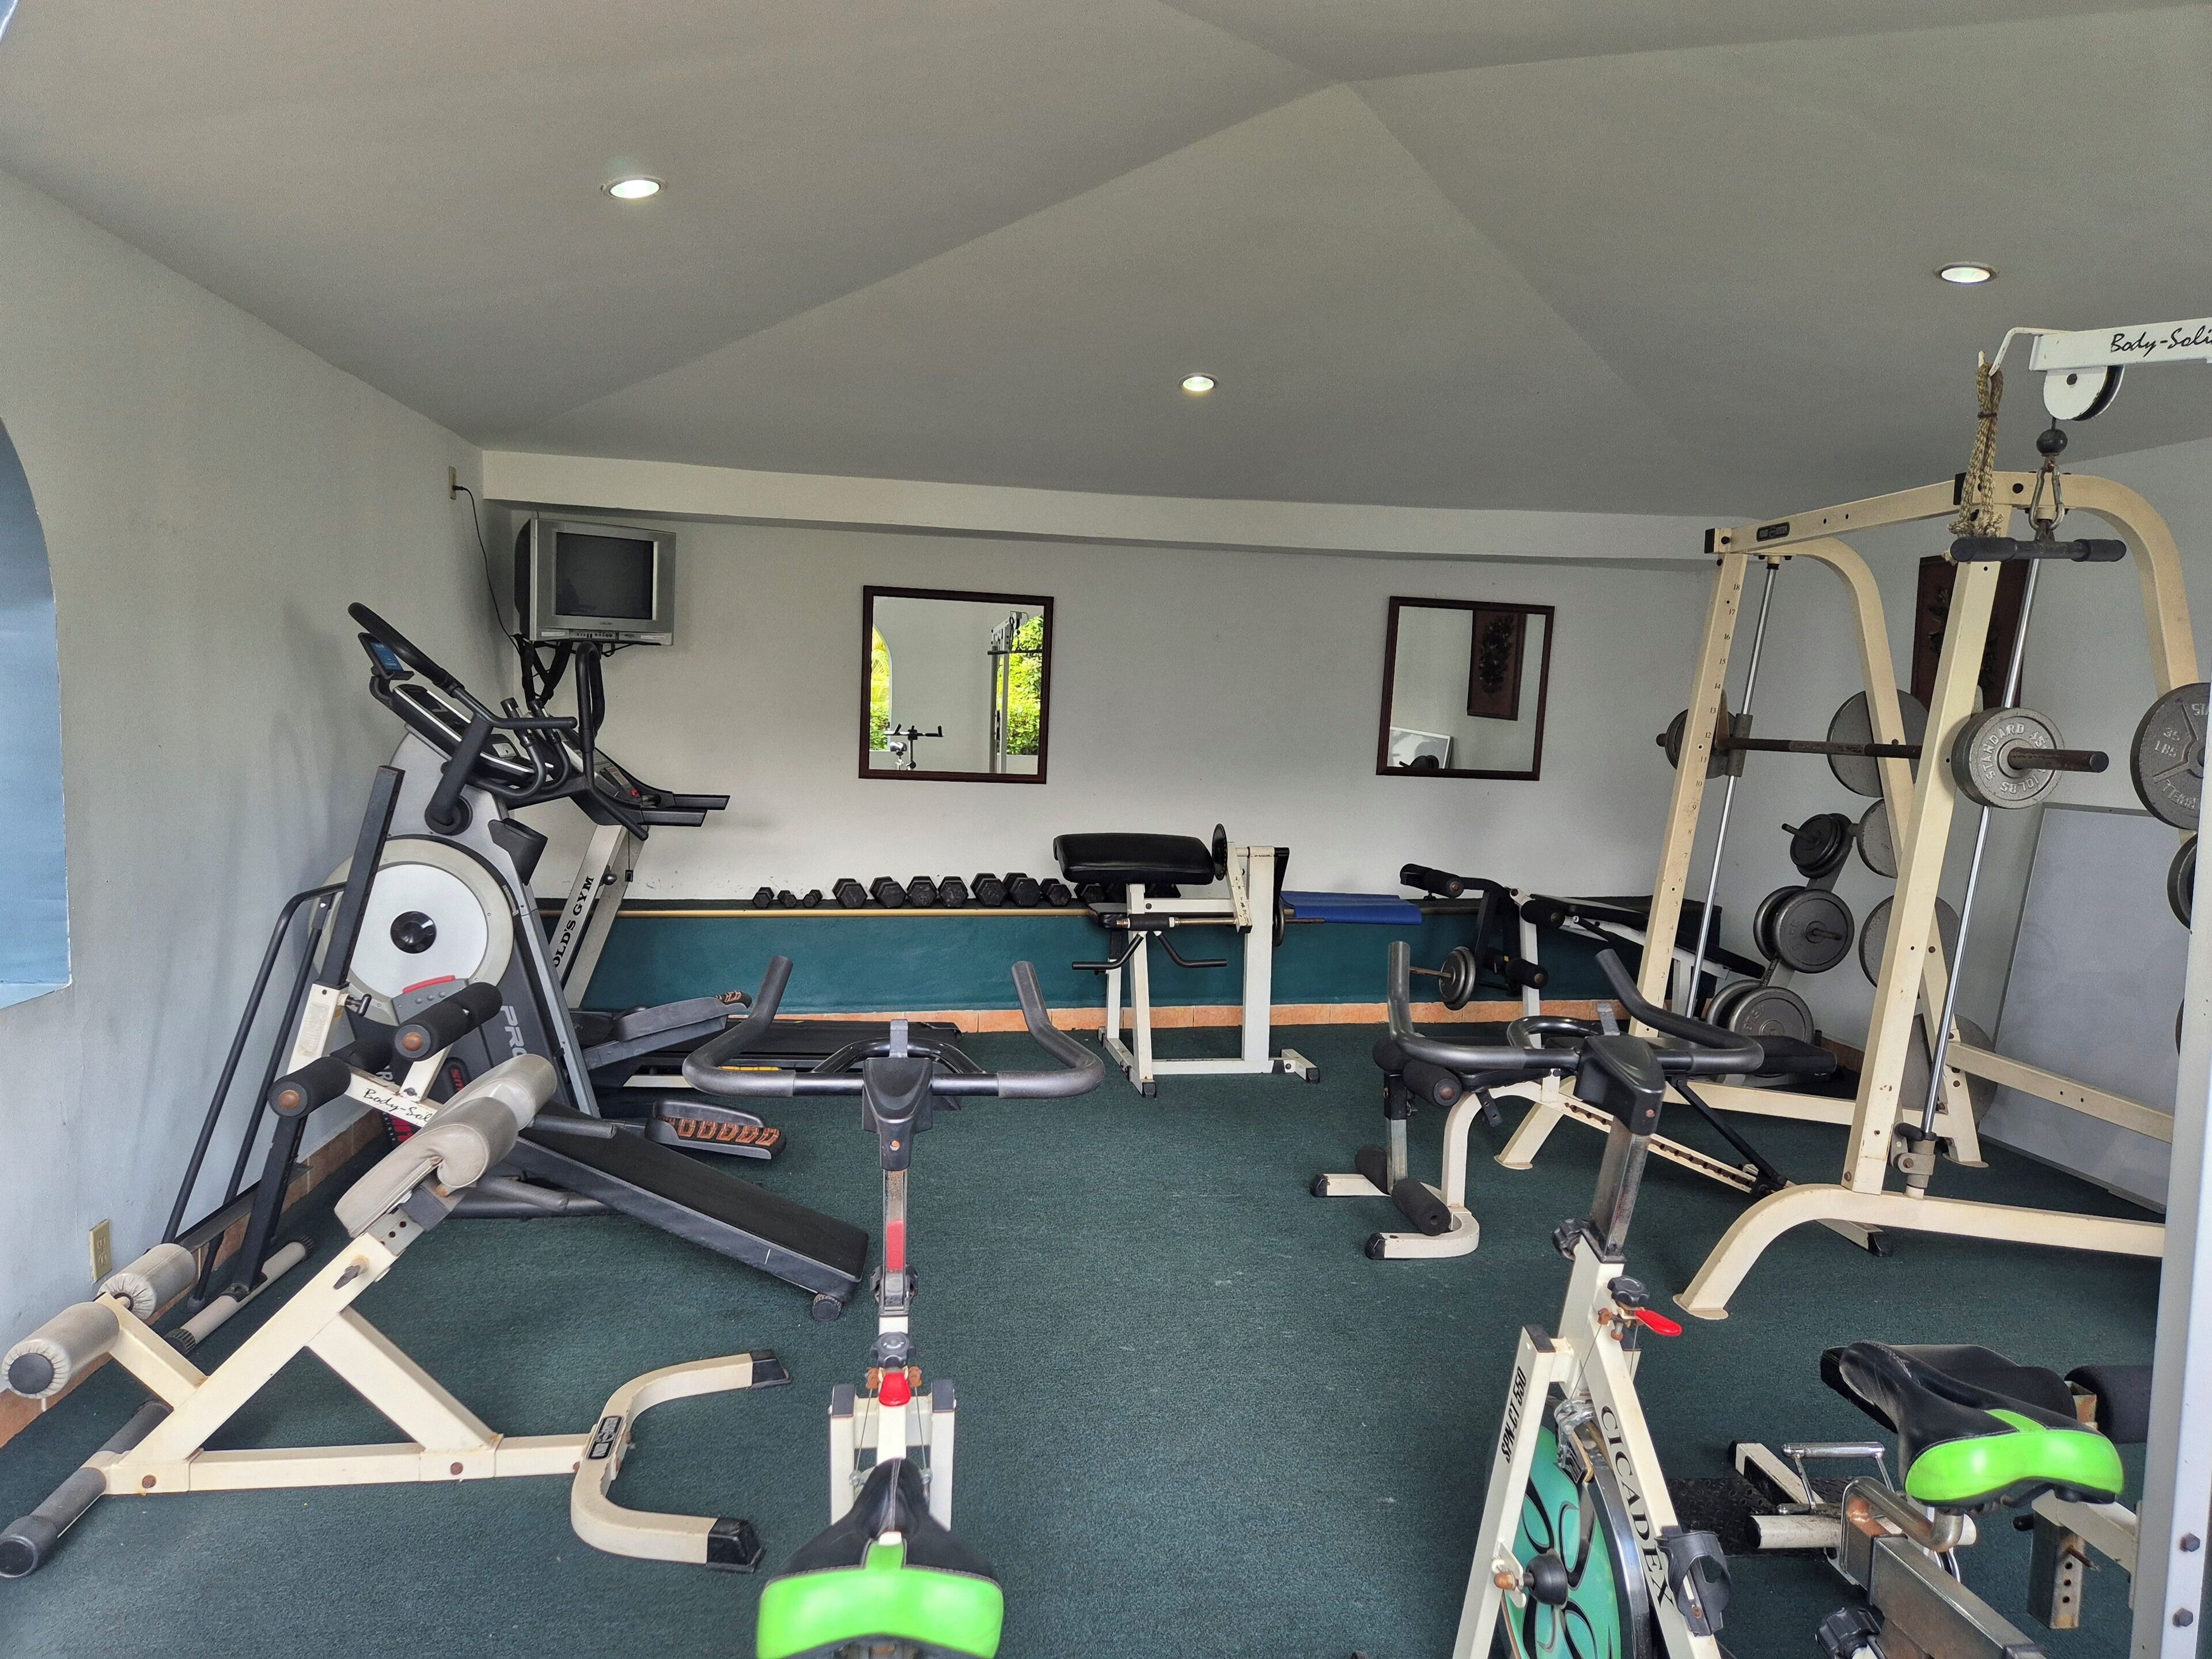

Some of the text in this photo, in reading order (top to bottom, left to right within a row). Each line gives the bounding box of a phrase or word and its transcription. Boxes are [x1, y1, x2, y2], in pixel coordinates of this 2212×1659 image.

[2111, 325, 2212, 358] Body-Soli
[1982, 723, 2025, 781] STANDARD
[2154, 740, 2178, 758] LBS
[2162, 727, 2180, 742] 35
[553, 876, 594, 968] OLD'S GYM
[363, 1088, 433, 1123] Body-Sol
[1501, 1365, 1527, 1464] SPN-CT 550
[1601, 1406, 1675, 1608] CICADEX
